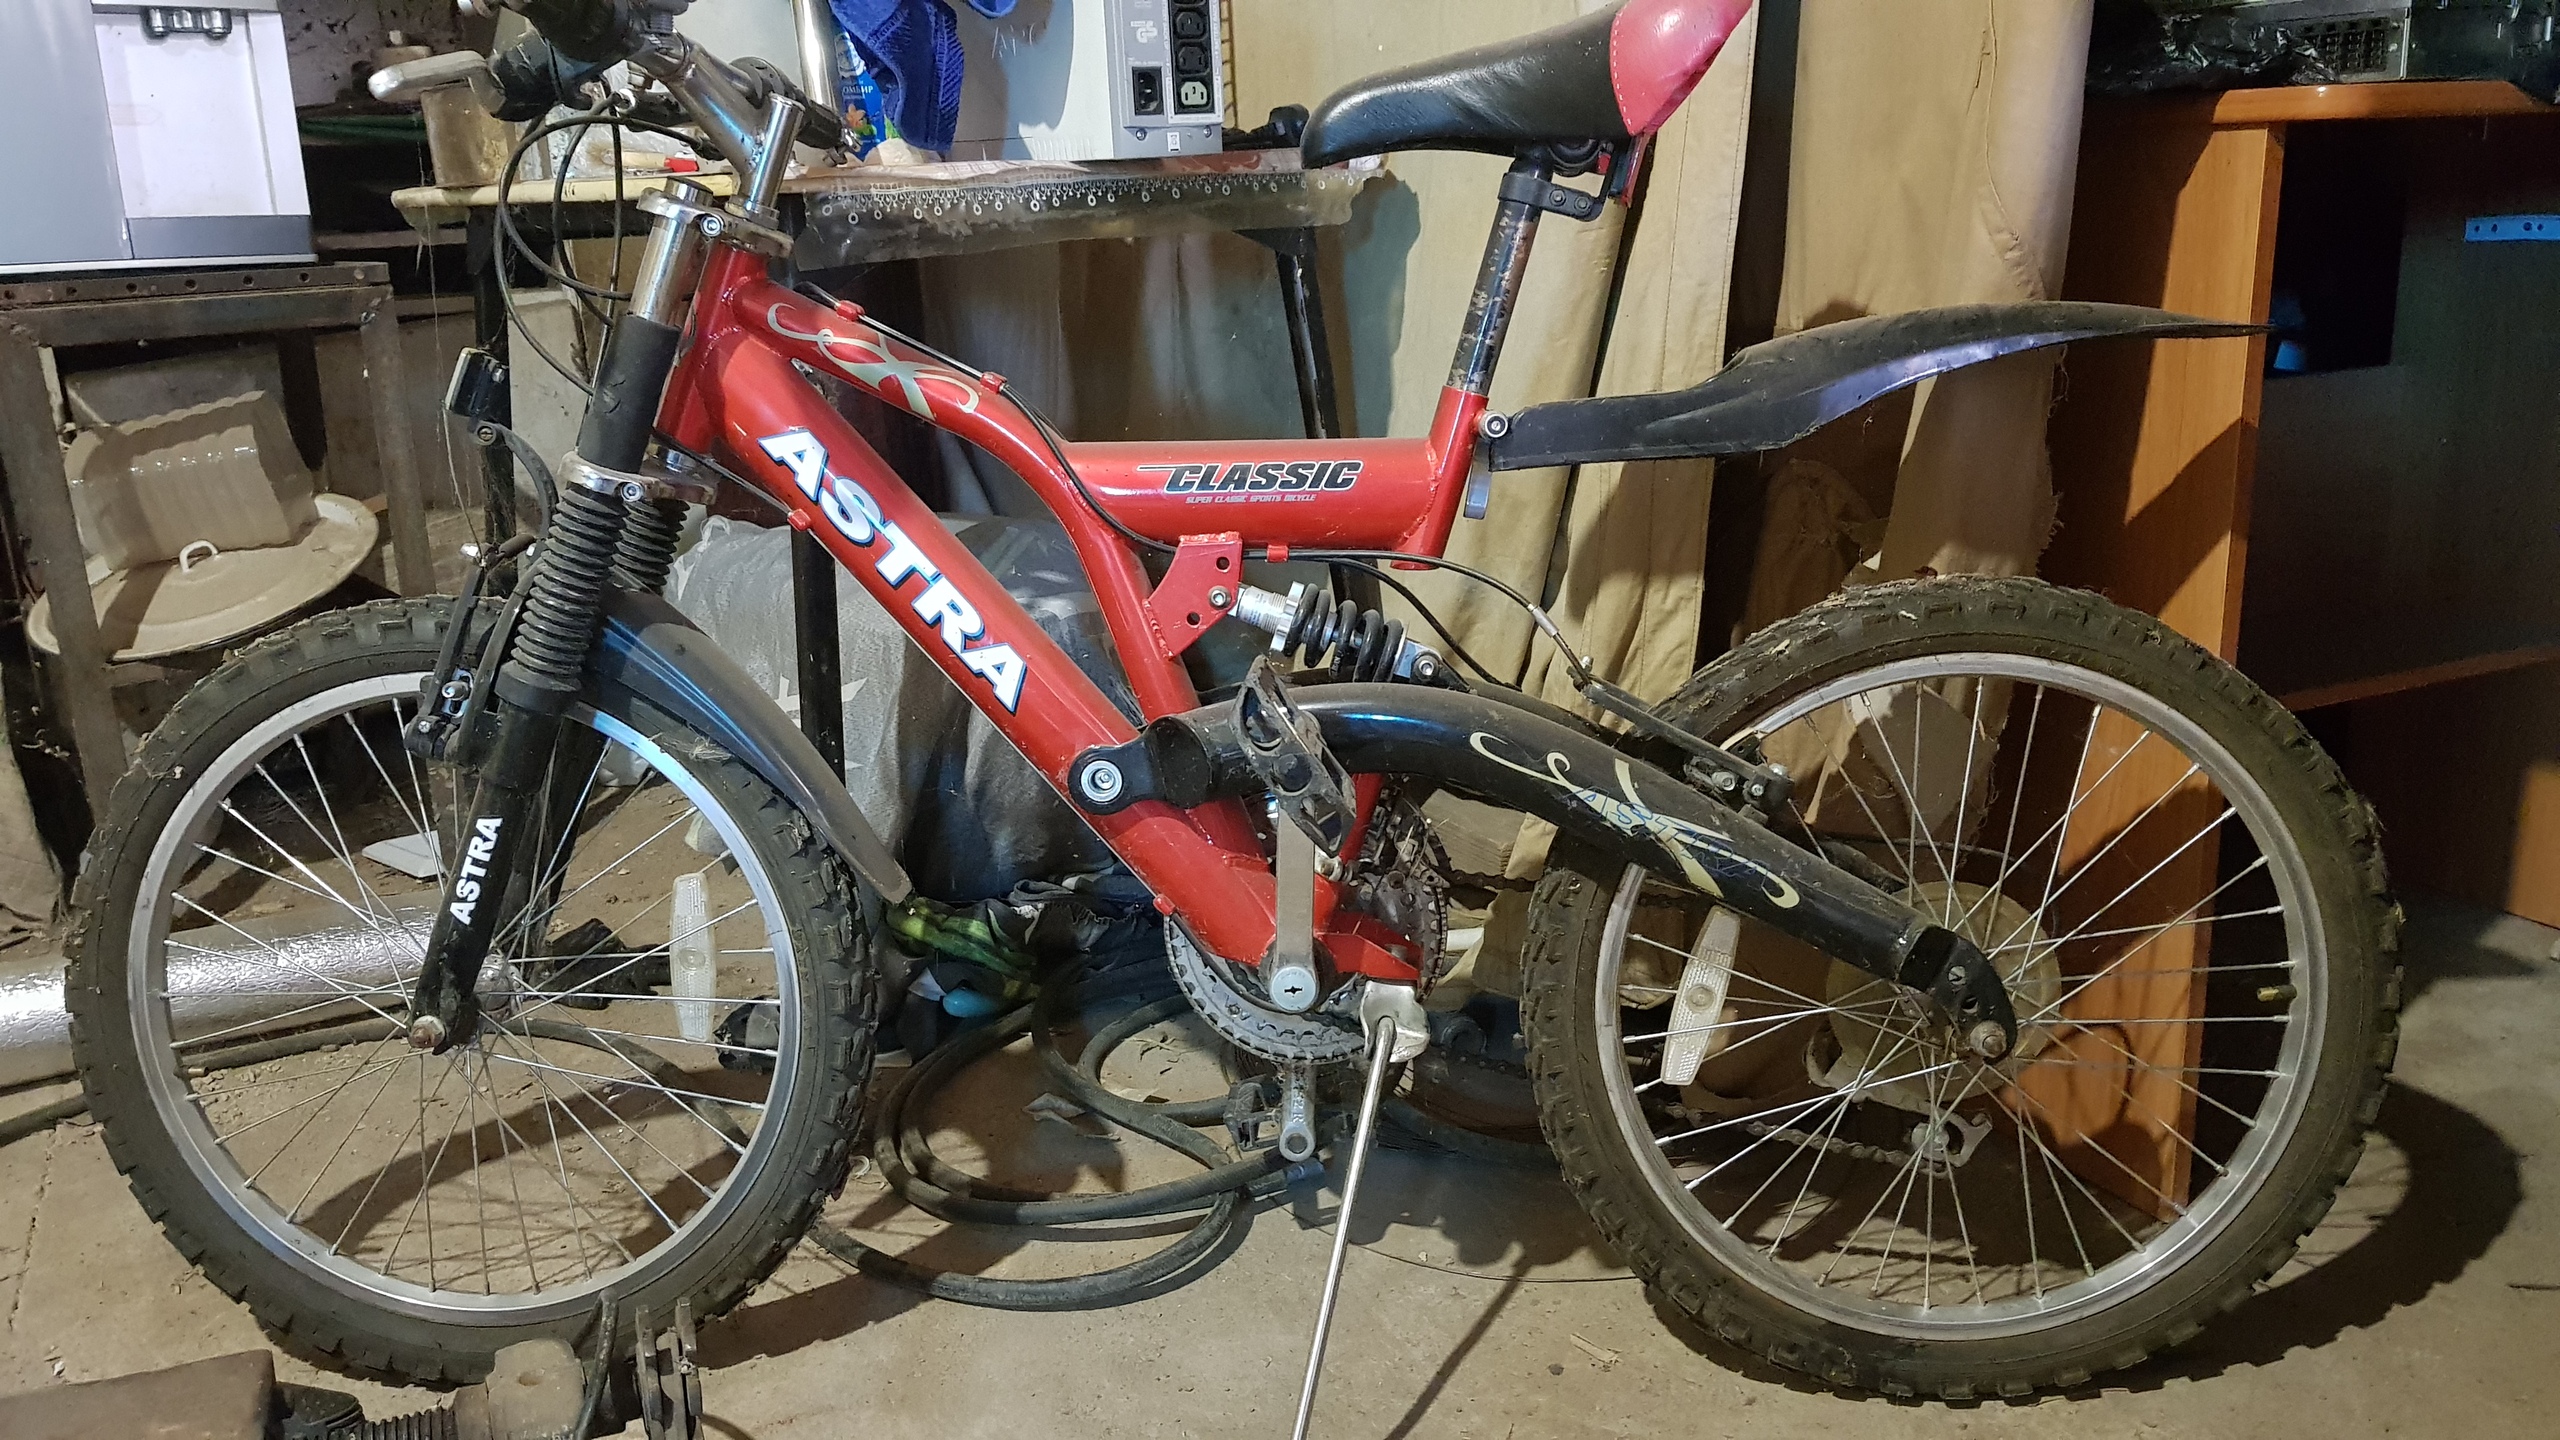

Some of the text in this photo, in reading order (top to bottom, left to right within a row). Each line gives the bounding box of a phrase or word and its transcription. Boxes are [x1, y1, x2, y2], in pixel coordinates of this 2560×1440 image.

[1136, 460, 1364, 494] CLASSIC
[1185, 493, 1317, 505] SUPER CLASSIC SPORTS BICYCLE
[757, 427, 1028, 716] ASTRA
[449, 817, 504, 926] ASTRA
